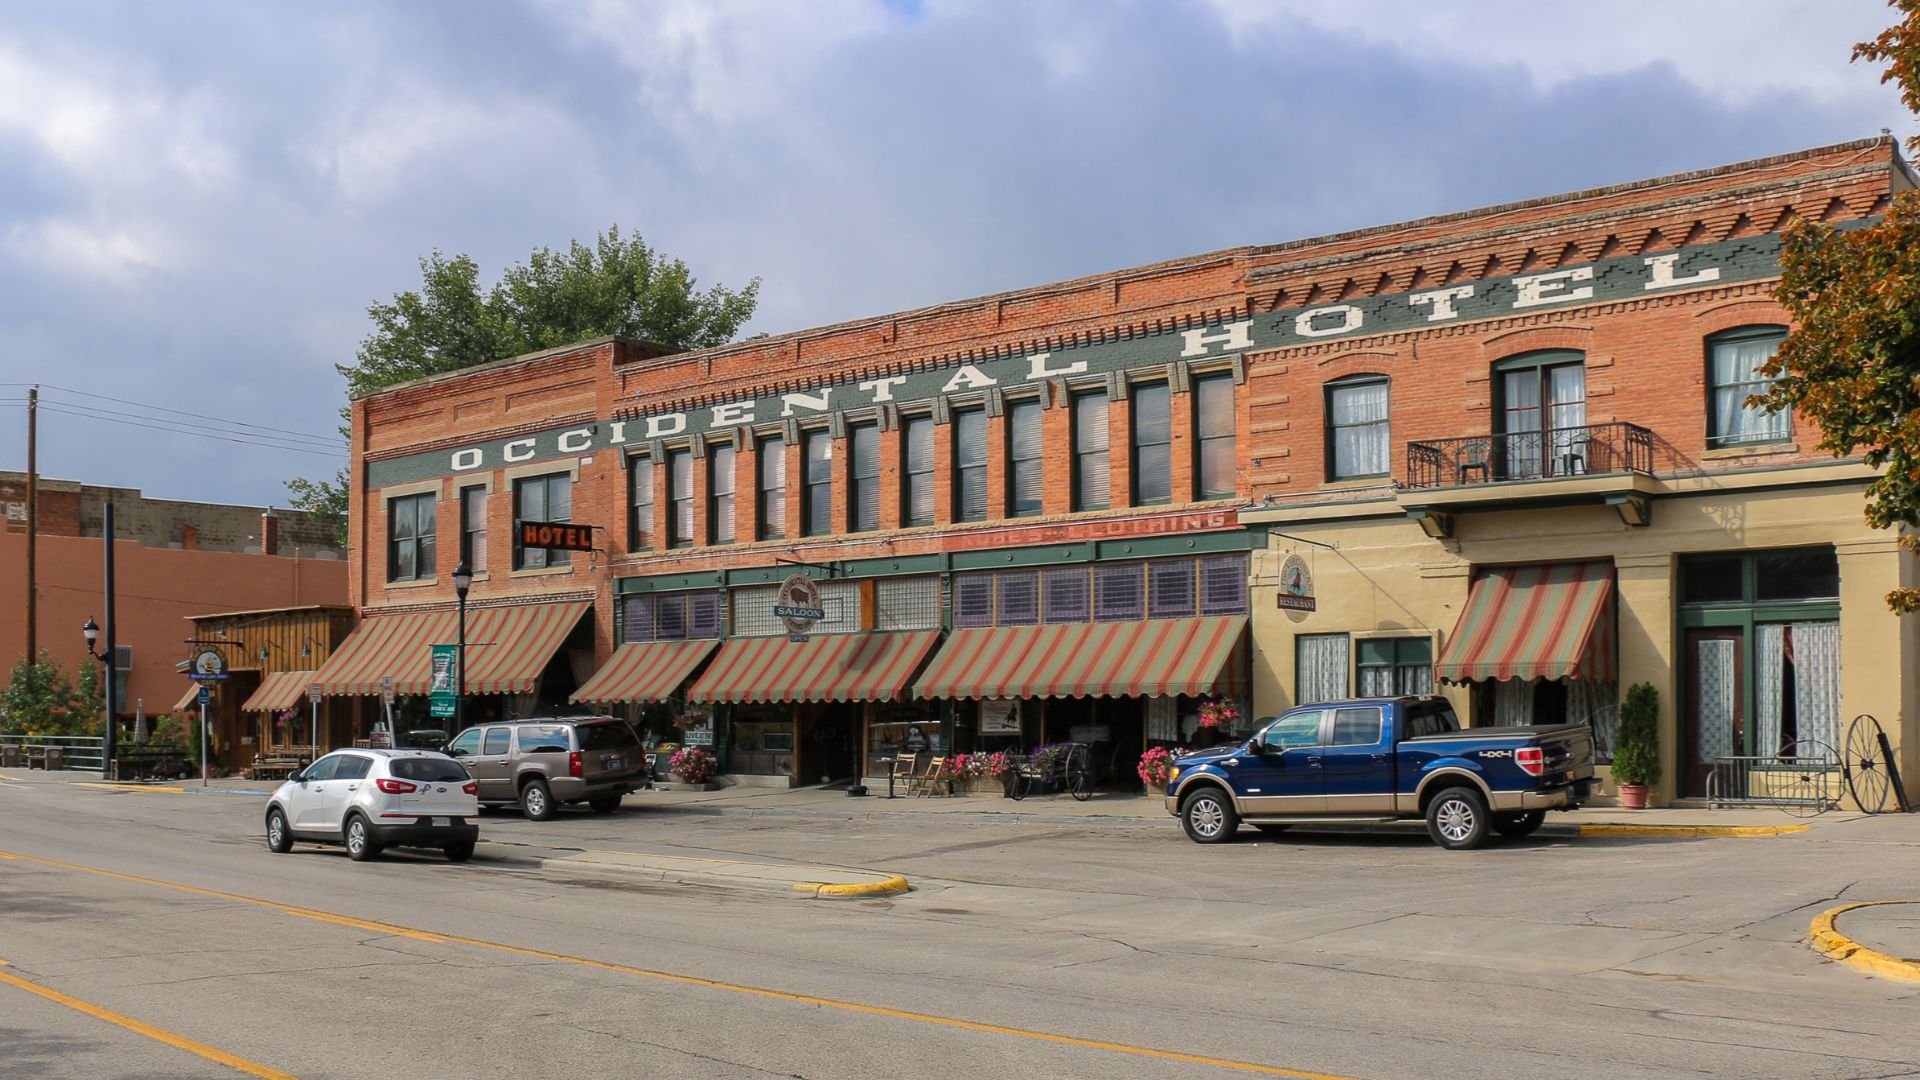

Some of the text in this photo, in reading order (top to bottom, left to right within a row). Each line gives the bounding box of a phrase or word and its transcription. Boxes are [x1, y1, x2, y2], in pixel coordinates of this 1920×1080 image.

[451, 252, 1720, 471] OCCIDENTAL HOTEL
[524, 524, 590, 547] HOTEL
[777, 607, 821, 618] SALOON
